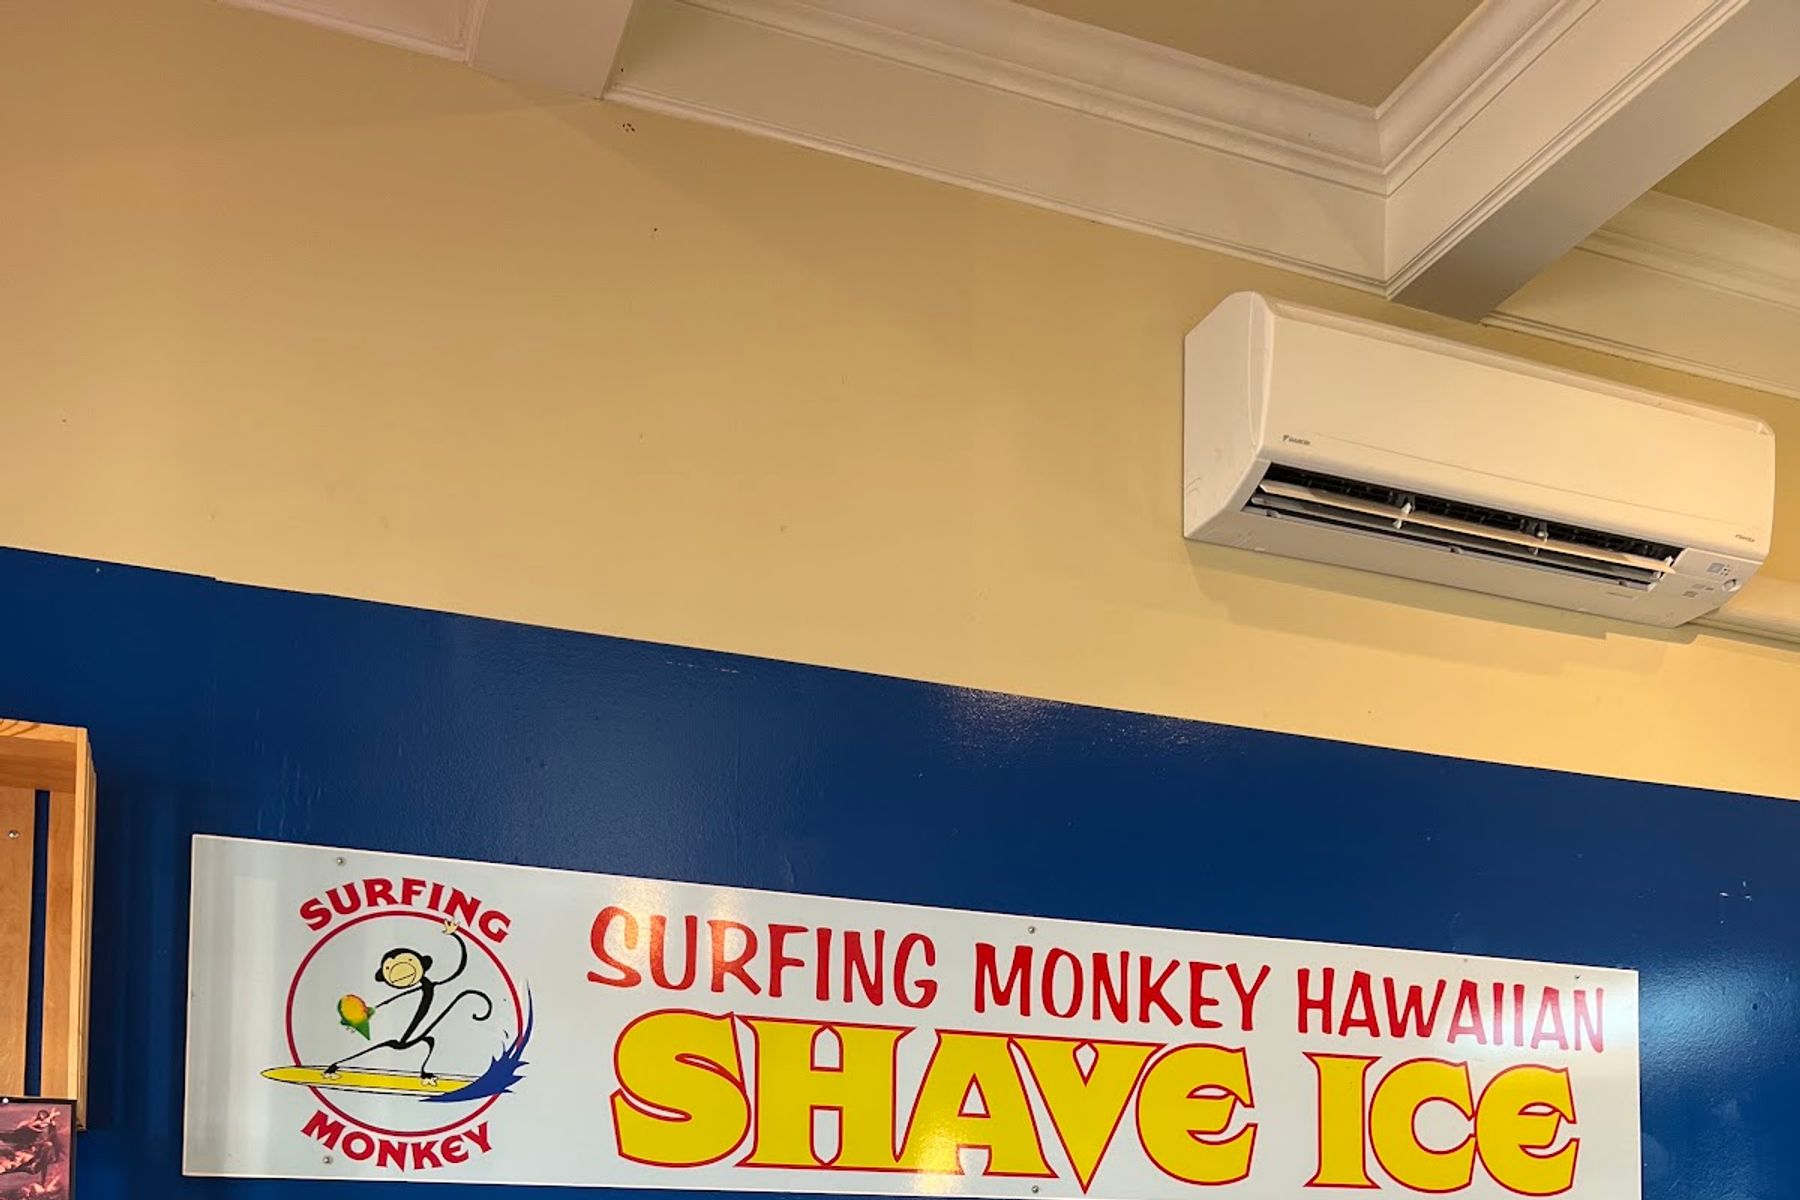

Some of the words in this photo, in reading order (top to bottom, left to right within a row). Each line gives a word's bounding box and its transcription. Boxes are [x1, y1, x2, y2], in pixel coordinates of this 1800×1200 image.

[299, 877, 512, 943] SURFING
[586, 905, 938, 1010] SURFING
[974, 942, 1271, 1032] MONKEY
[1297, 967, 1606, 1053] HAWAIIAN
[300, 1109, 493, 1173] MONKEY
[609, 1007, 1257, 1195] SHAVE
[1302, 1051, 1581, 1197] ICE
